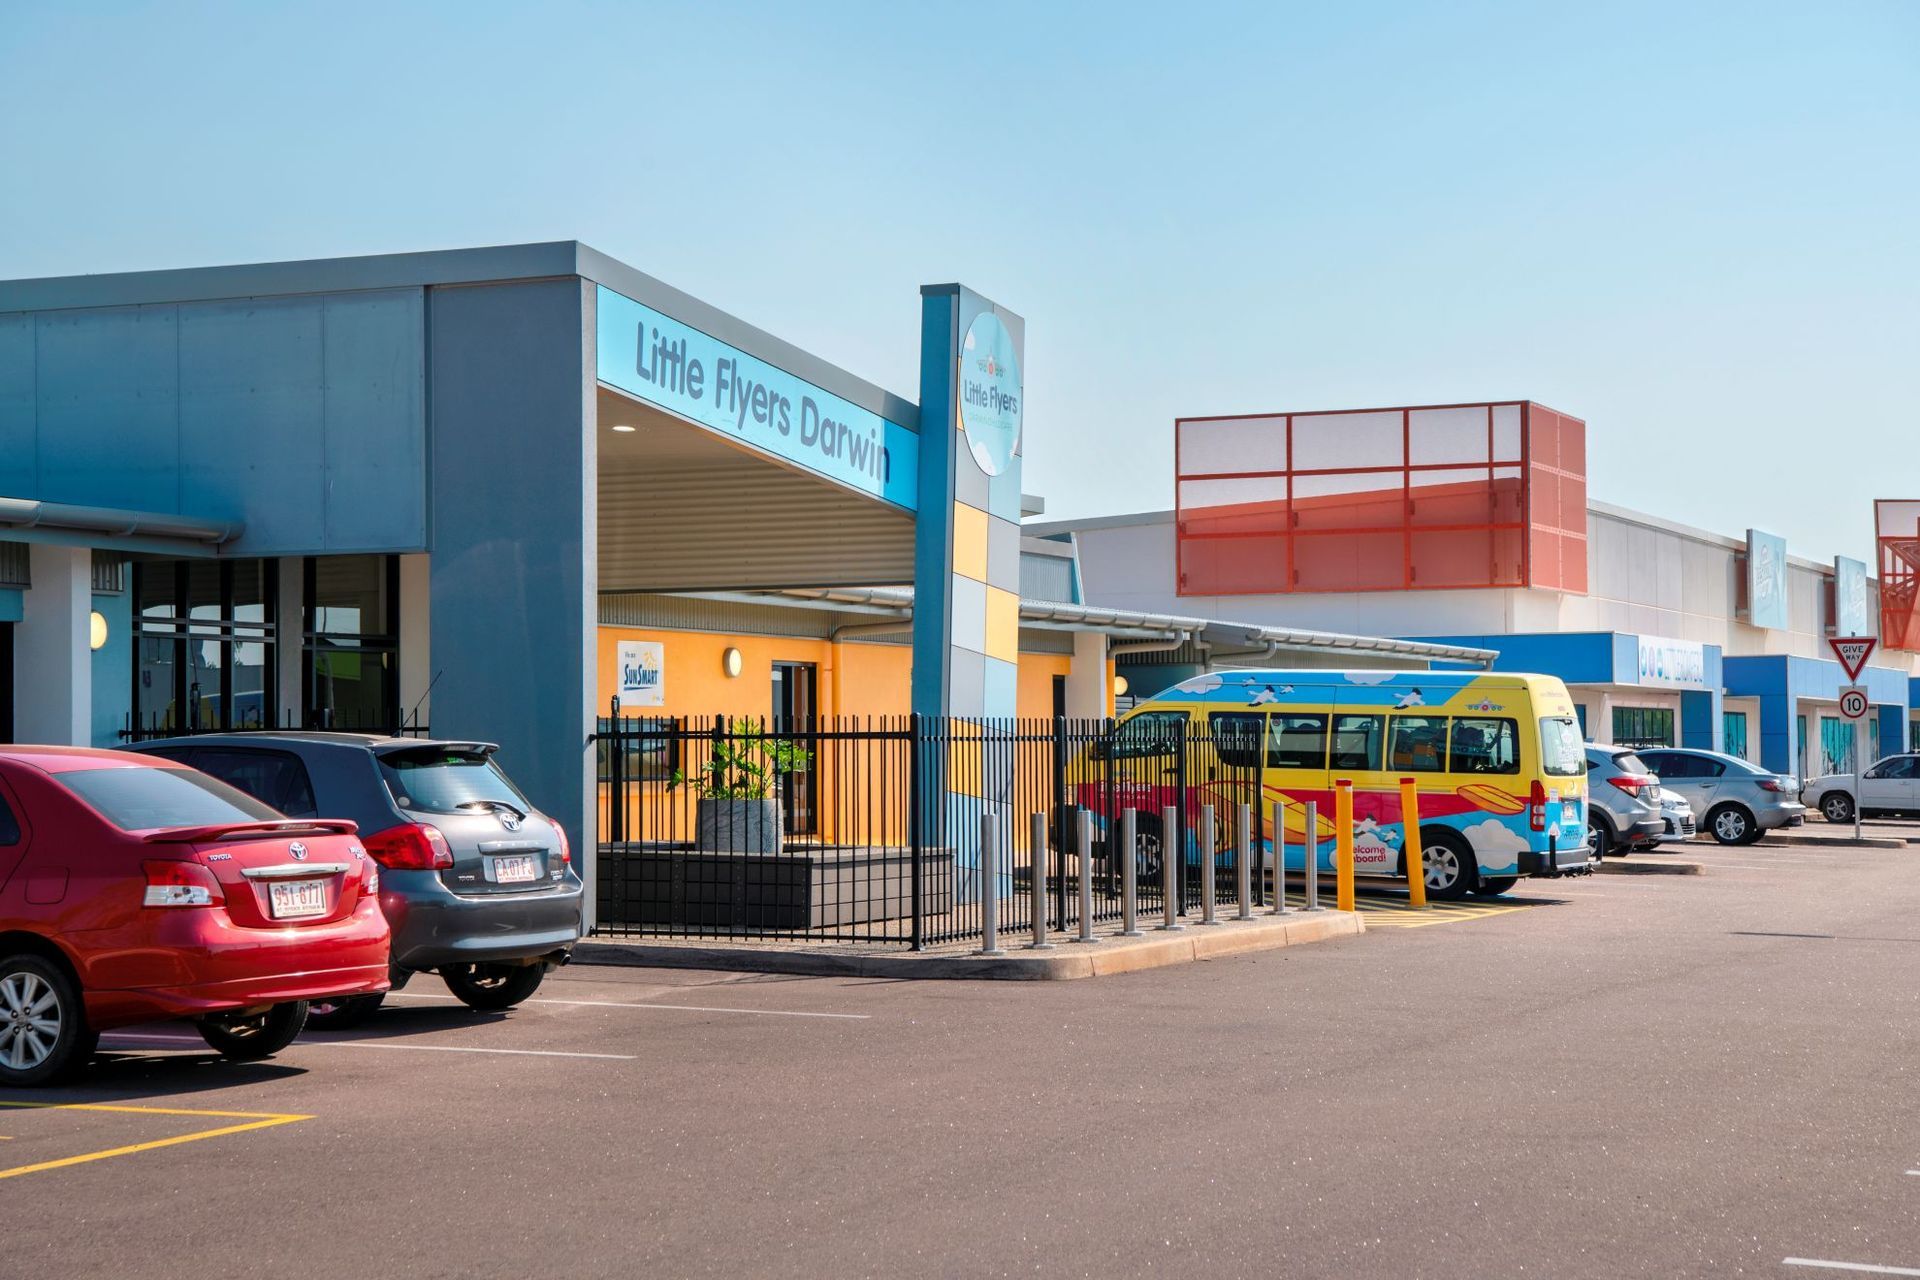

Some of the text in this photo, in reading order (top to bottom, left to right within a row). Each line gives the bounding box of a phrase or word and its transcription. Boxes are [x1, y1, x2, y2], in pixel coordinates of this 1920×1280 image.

[964, 379, 1018, 415] Little Flyers
[636, 321, 890, 484] Little Flyers Darwin
[1842, 645, 1864, 654] GIVE
[1847, 697, 1862, 712] 10
[1353, 845, 1386, 854] elcome
[208, 853, 233, 862] TOYOTA
[1353, 853, 1386, 862] board!
